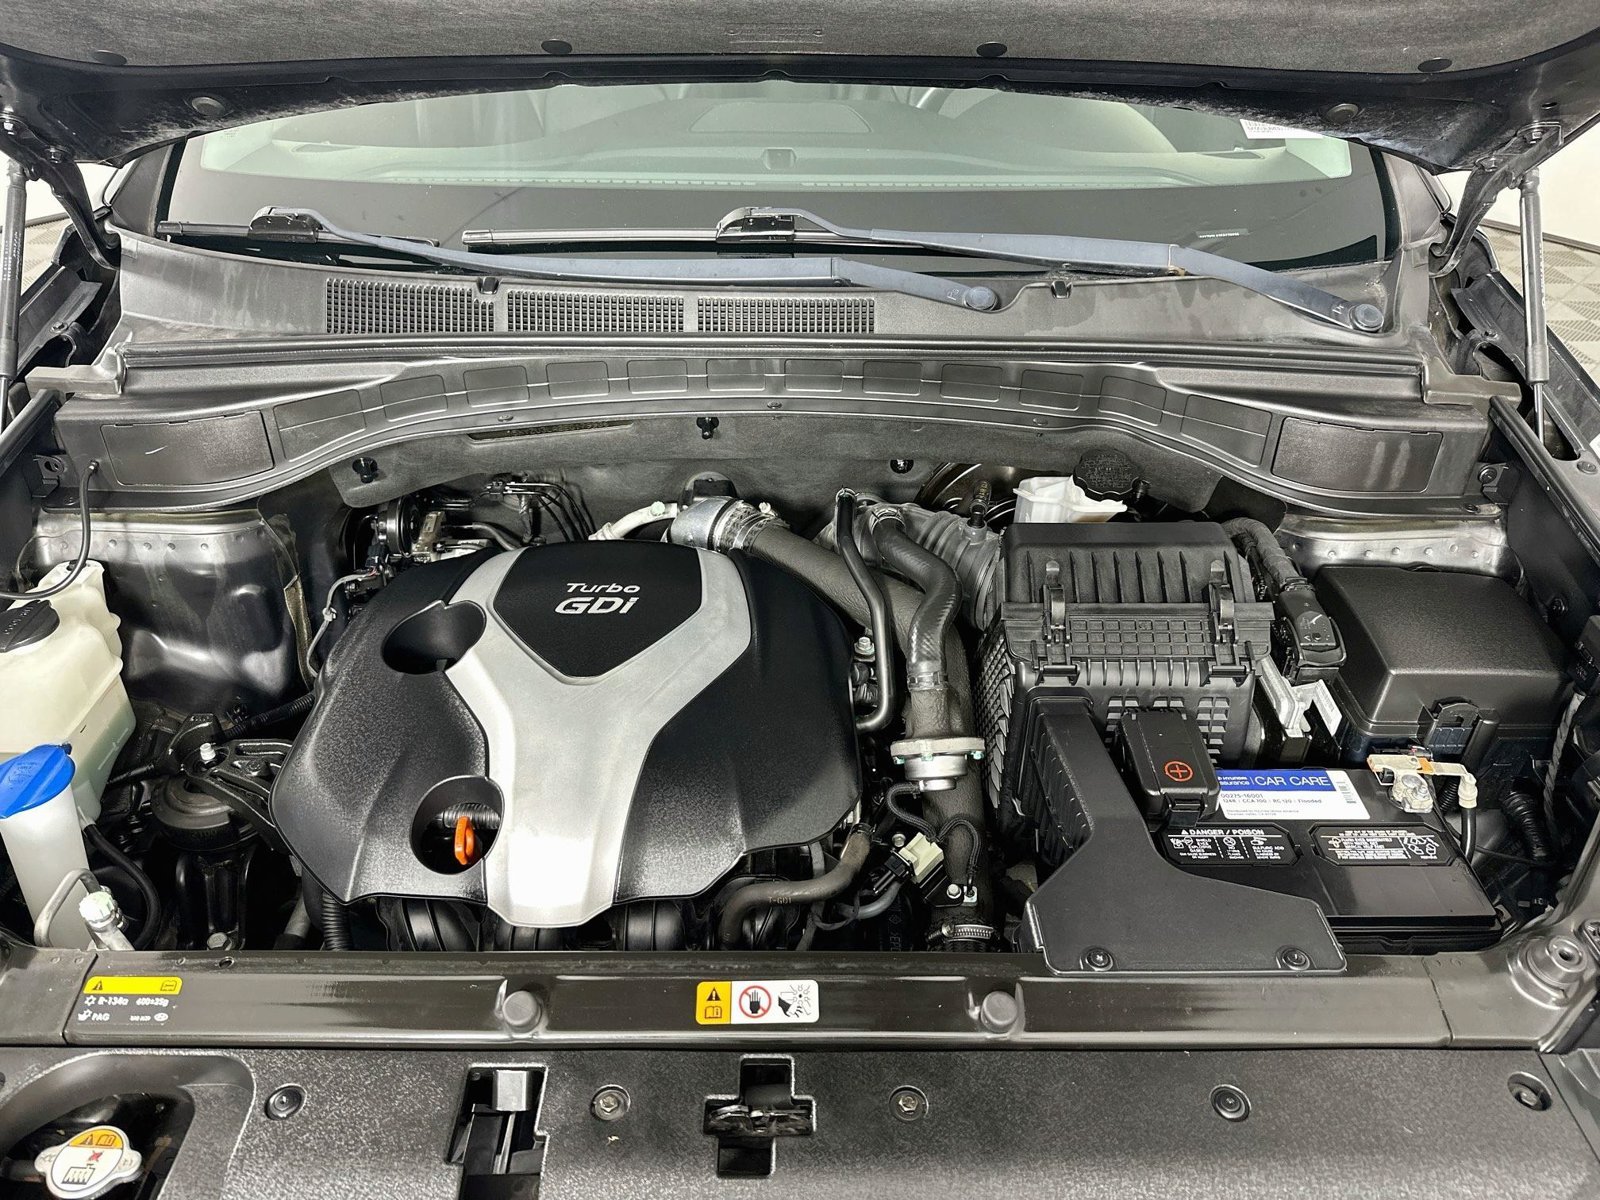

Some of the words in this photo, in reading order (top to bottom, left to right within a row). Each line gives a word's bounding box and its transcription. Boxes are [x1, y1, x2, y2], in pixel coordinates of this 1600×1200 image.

[566, 582, 641, 594] Turbo
[554, 596, 640, 615] GDi
[1254, 775, 1287, 786] CAR
[1289, 775, 1331, 786] CARE
[91, 1012, 111, 1021] PAG
